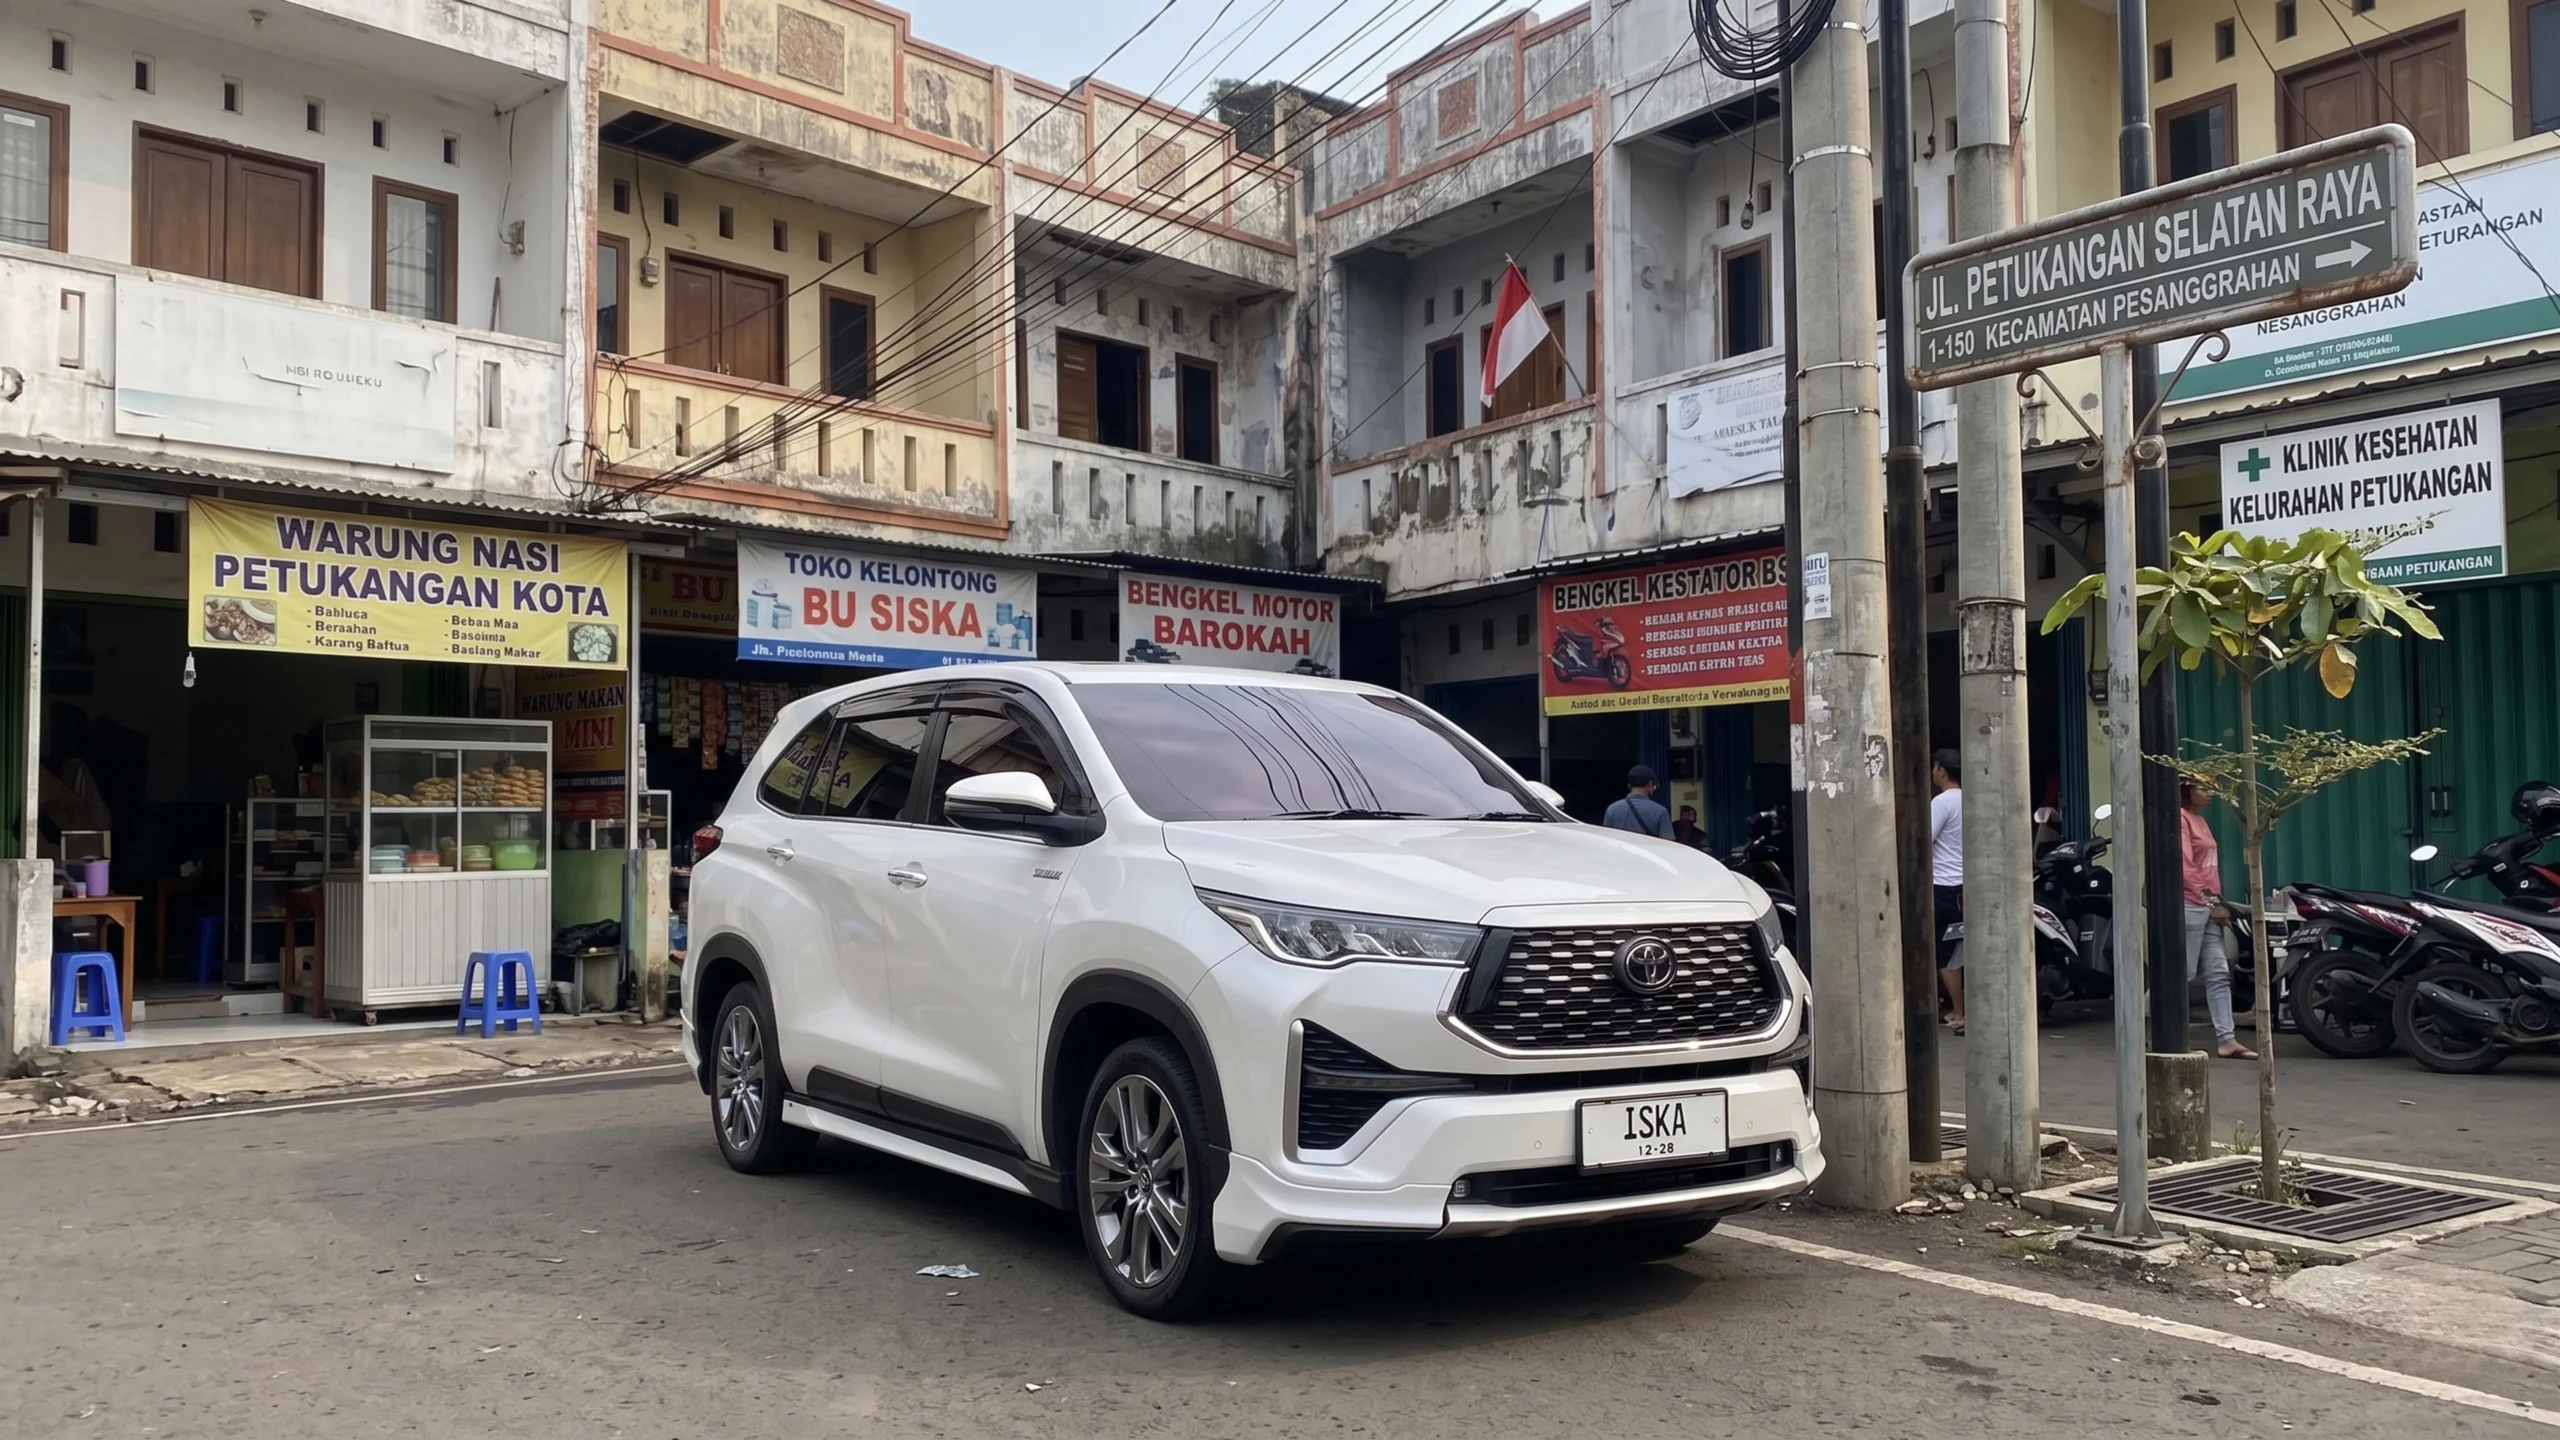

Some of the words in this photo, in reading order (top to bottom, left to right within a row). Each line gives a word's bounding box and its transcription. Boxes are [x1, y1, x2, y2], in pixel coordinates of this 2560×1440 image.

[1926, 274, 1960, 321] JL.
[1967, 221, 2146, 311] PETUKANGAN
[2154, 185, 2287, 263] SELATAN
[2298, 161, 2382, 229] RAYA
[1928, 330, 1975, 364] 1-150
[1986, 298, 2107, 351] KECAMATAN
[2113, 252, 2301, 322] PESANGGRAHAN
[2257, 292, 2406, 336] NESANGGRAHAN
[2283, 435, 2349, 474] KLINIK
[2355, 415, 2478, 463] KESEHATAN
[2230, 482, 2344, 525] KELURAHAN
[2351, 461, 2492, 509] PETUKANGAN
[276, 515, 459, 565] WARUNG
[473, 536, 560, 573] NASI
[2408, 555, 2493, 576] PETUKANGAN
[214, 554, 499, 609] PETUKANGAN
[513, 580, 610, 617] KOTA
[784, 551, 852, 580] TOKO
[859, 559, 998, 595] KELONTONG
[1554, 578, 1642, 612] BENGKEL
[1648, 562, 1757, 601] KESTATOR
[803, 586, 857, 629] BU
[870, 593, 983, 639] SISKA
[1127, 579, 1245, 615] BENGKEL
[1252, 593, 1334, 623] MOTOR
[315, 636, 363, 652] Karang
[1154, 615, 1310, 656] BAROKAH
[521, 691, 573, 715] WARUNG
[577, 684, 626, 710] MAKAN
[564, 716, 615, 750] MINI
[1624, 1102, 1687, 1140] ISKA
[1638, 1142, 1675, 1156] 12-28
